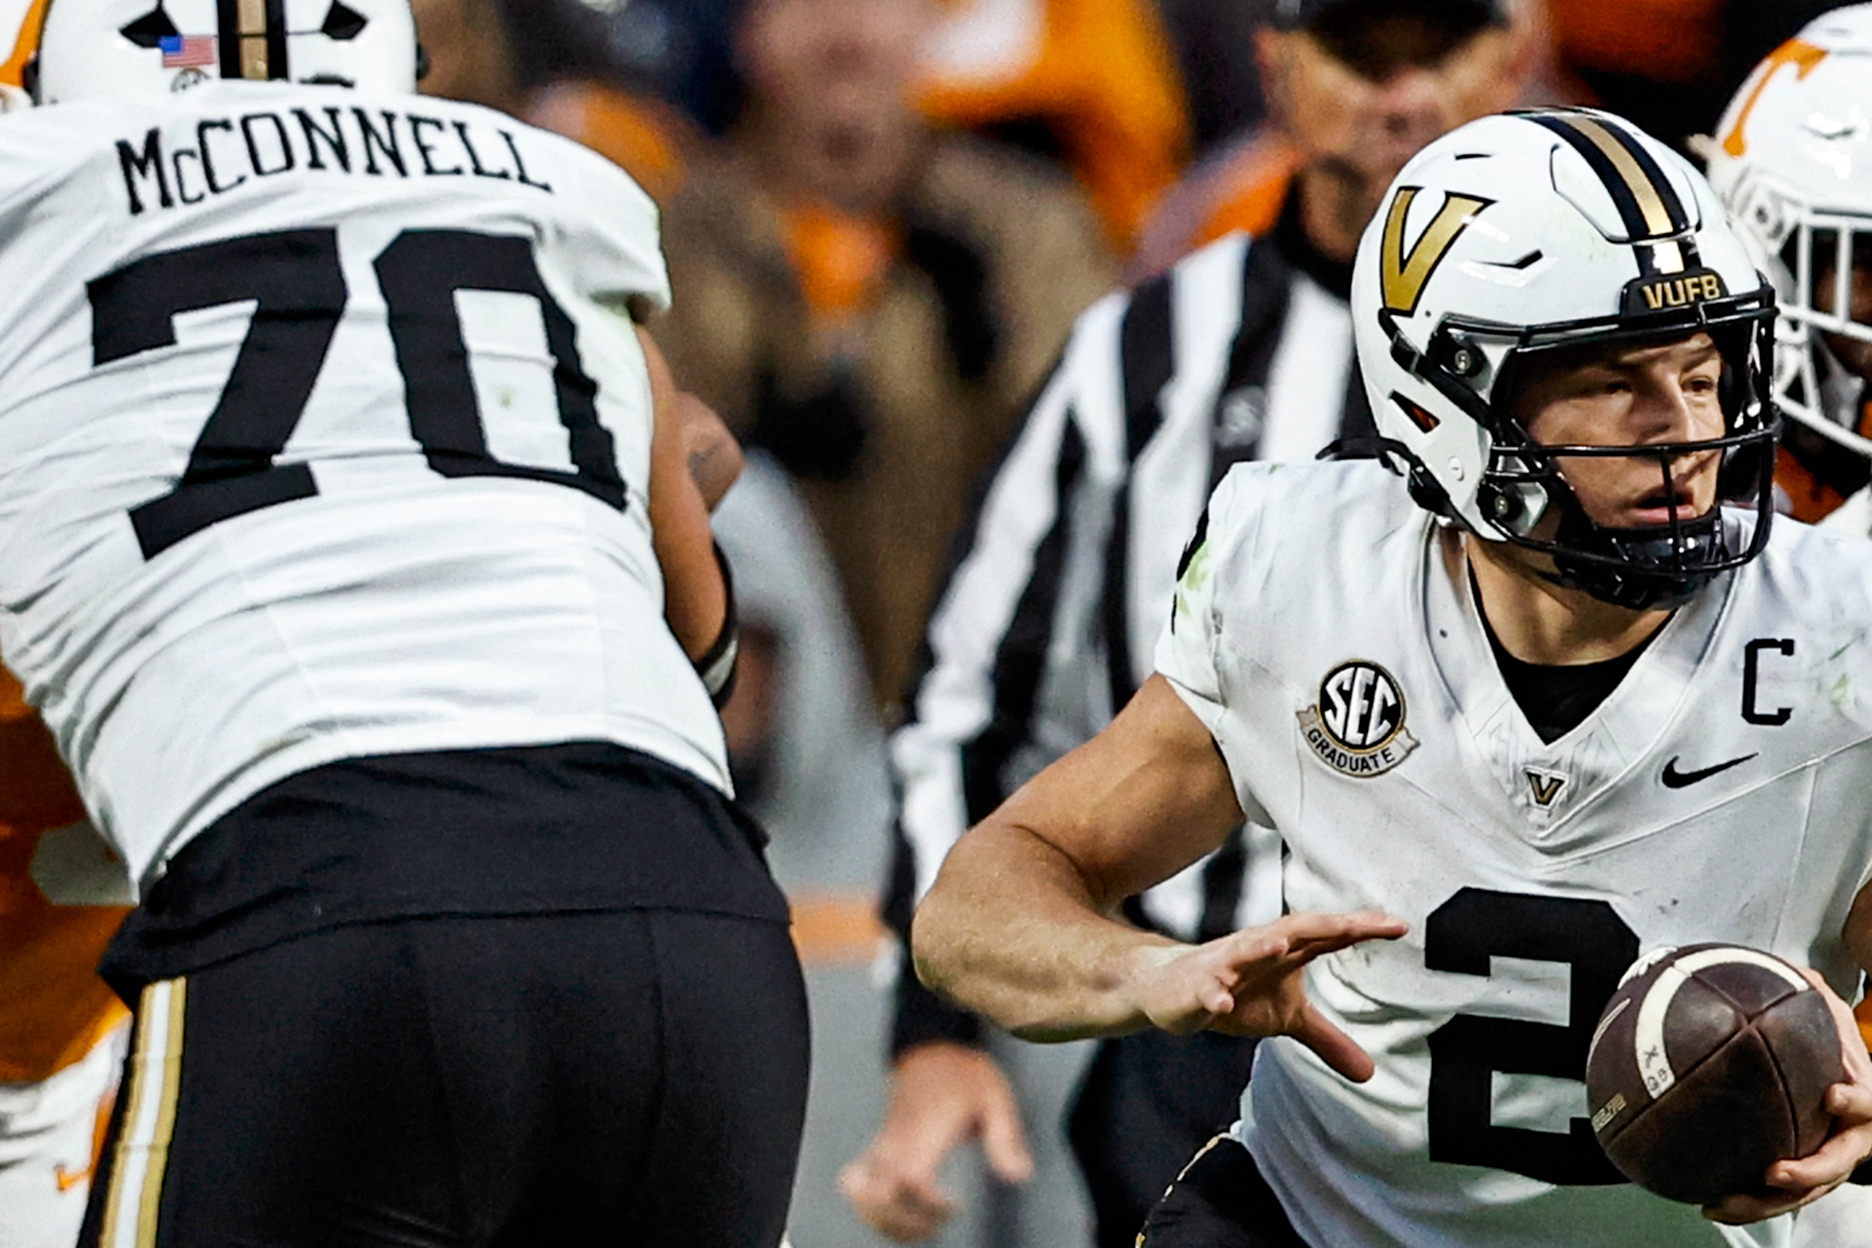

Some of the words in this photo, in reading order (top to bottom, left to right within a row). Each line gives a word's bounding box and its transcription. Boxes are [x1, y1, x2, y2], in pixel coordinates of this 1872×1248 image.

[116, 106, 553, 215] McCONNELL
[1379, 185, 1498, 318] V
[1642, 274, 1723, 310] VUFB
[86, 226, 627, 560] 70
[1322, 666, 1398, 748] SEC
[1741, 638, 1795, 726] C
[1306, 727, 1396, 773] GRADUATE
[1526, 771, 1566, 806] V
[1424, 888, 1640, 1187] 2
